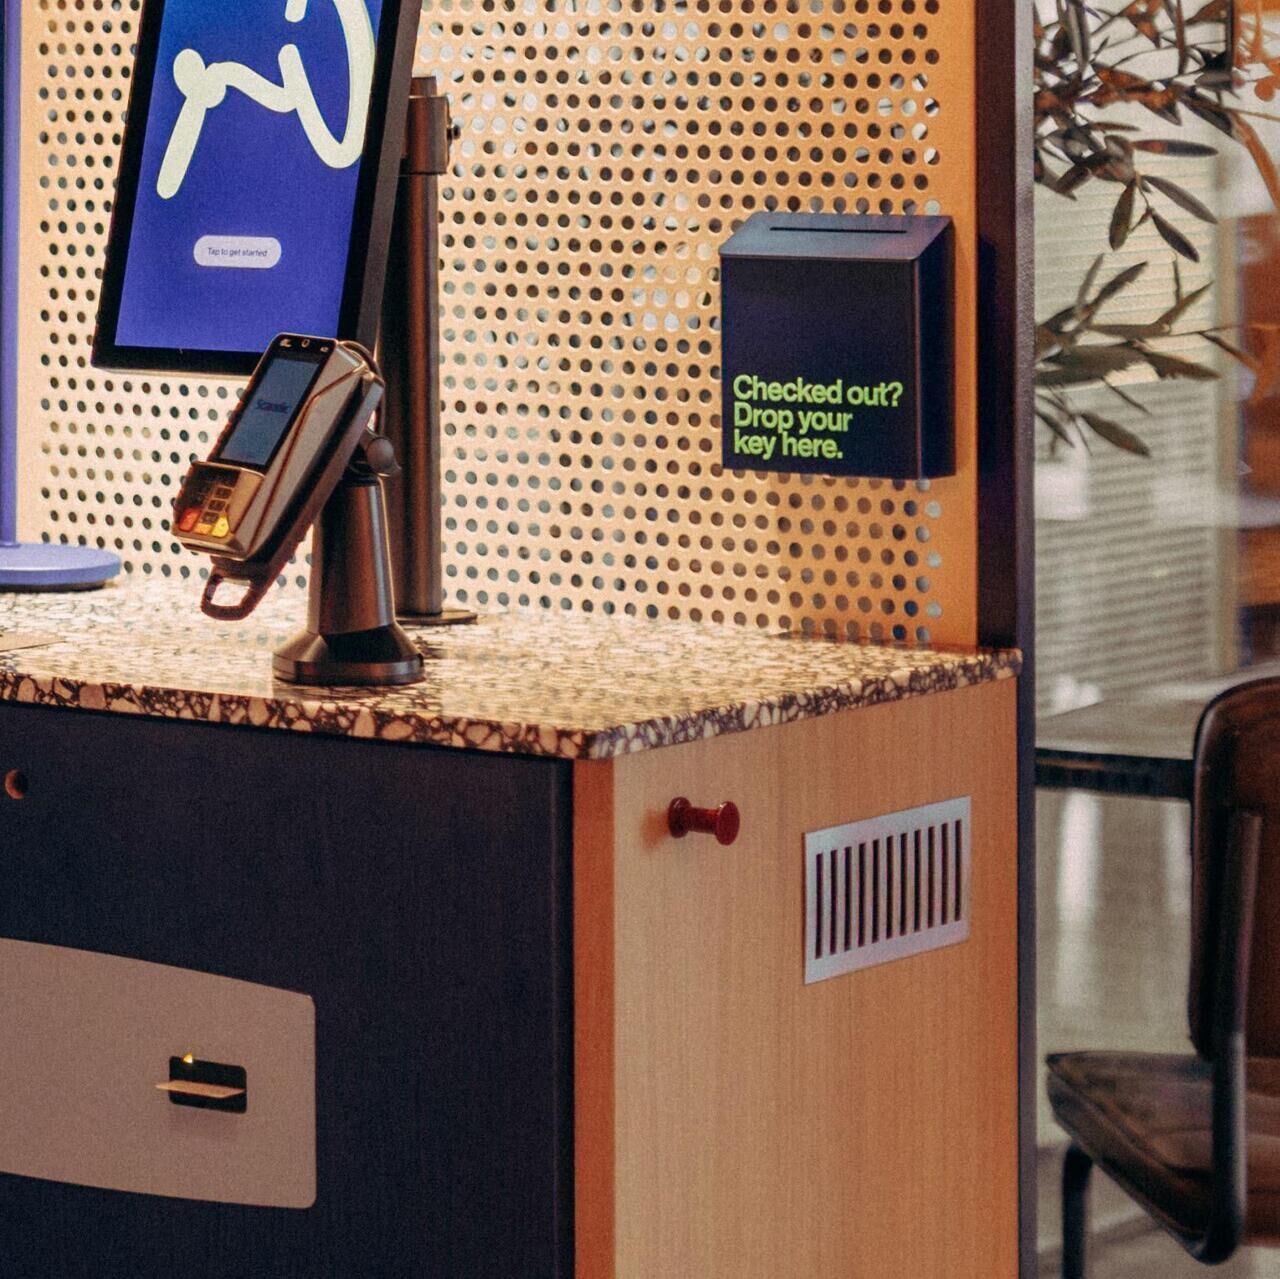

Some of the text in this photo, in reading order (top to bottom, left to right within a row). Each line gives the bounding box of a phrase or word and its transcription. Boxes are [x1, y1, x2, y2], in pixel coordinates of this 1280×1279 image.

[207, 247, 221, 257] Tap
[229, 248, 241, 258] get
[242, 249, 268, 258] started
[733, 374, 904, 408] Checked out?
[733, 401, 854, 435] Drop your
[733, 428, 844, 461] key here.
